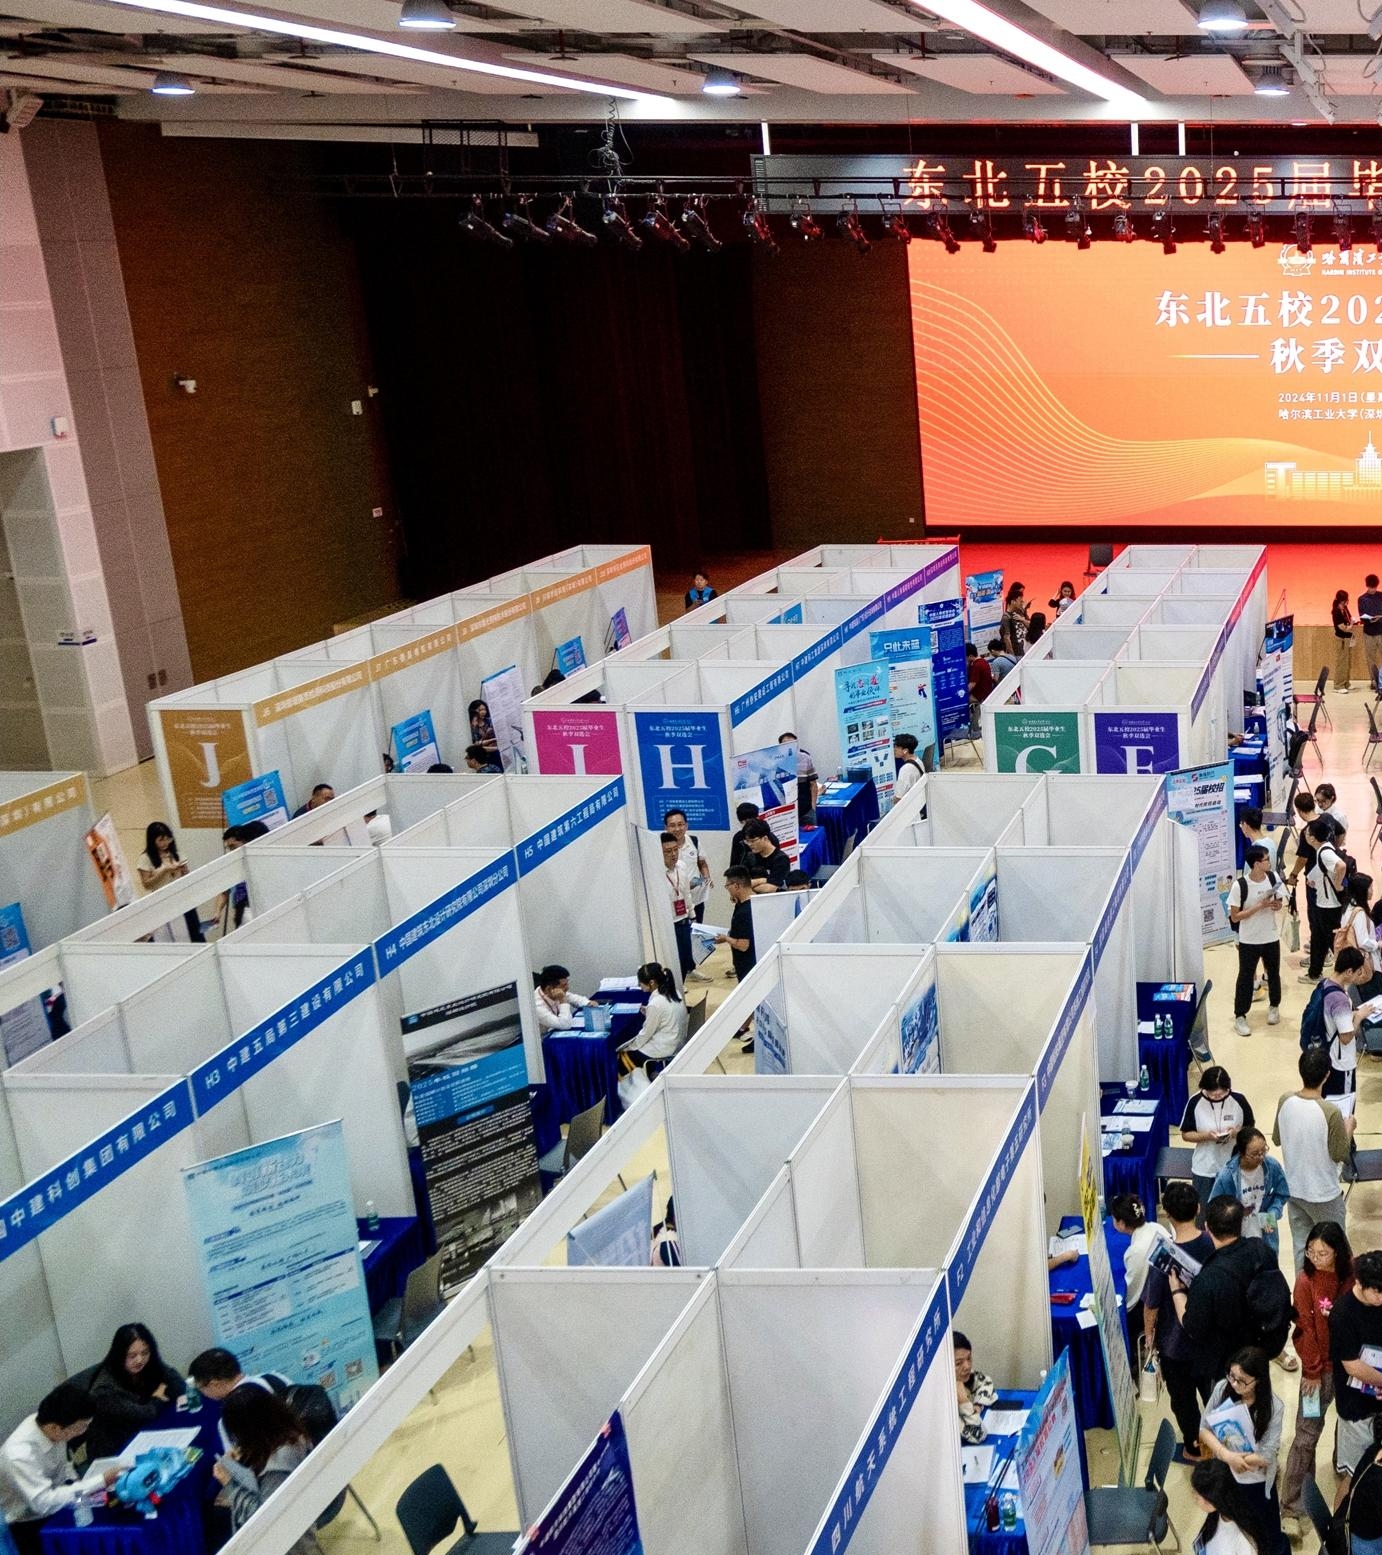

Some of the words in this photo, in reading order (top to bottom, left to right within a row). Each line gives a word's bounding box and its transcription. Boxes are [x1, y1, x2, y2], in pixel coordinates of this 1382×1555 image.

[198, 742, 221, 788] J
[653, 744, 711, 790] H
[524, 846, 534, 861] H5
[537, 786, 620, 852] 中国建筑第六工程局有限公司
[385, 942, 398, 960] H4
[205, 1070, 221, 1090] H3
[226, 962, 366, 1073] 中建五局第三建设有限公司
